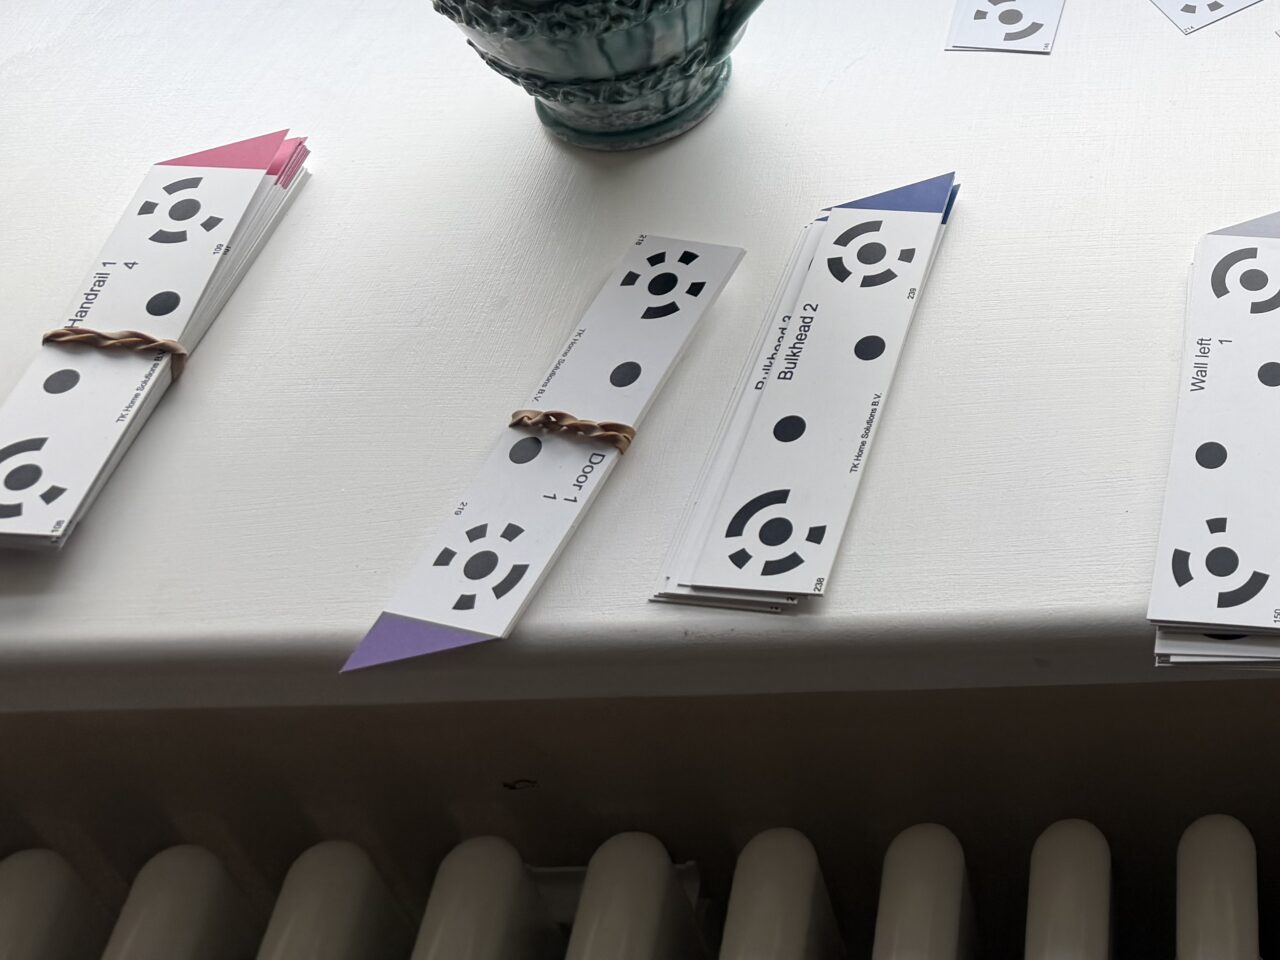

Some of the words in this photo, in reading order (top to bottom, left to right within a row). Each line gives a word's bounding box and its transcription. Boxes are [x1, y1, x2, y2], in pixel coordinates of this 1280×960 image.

[212, 243, 224, 256] 109
[123, 260, 139, 270] 4
[64, 272, 111, 329] Handrail
[907, 287, 916, 300] 239
[575, 328, 587, 338] TK
[777, 316, 814, 381] Bulkhead
[803, 303, 819, 312] 2
[562, 338, 579, 358] Home
[1194, 337, 1212, 358] left
[541, 359, 566, 388] Solutions
[1190, 362, 1209, 392] Wall
[115, 412, 129, 424] TK
[122, 392, 141, 414] Home
[136, 362, 160, 392] Solutions
[871, 392, 883, 407] B.V.
[861, 407, 878, 439] Solutions
[853, 440, 867, 462] Home
[572, 452, 606, 491] Door
[849, 462, 861, 474] TK
[813, 577, 825, 593] 238
